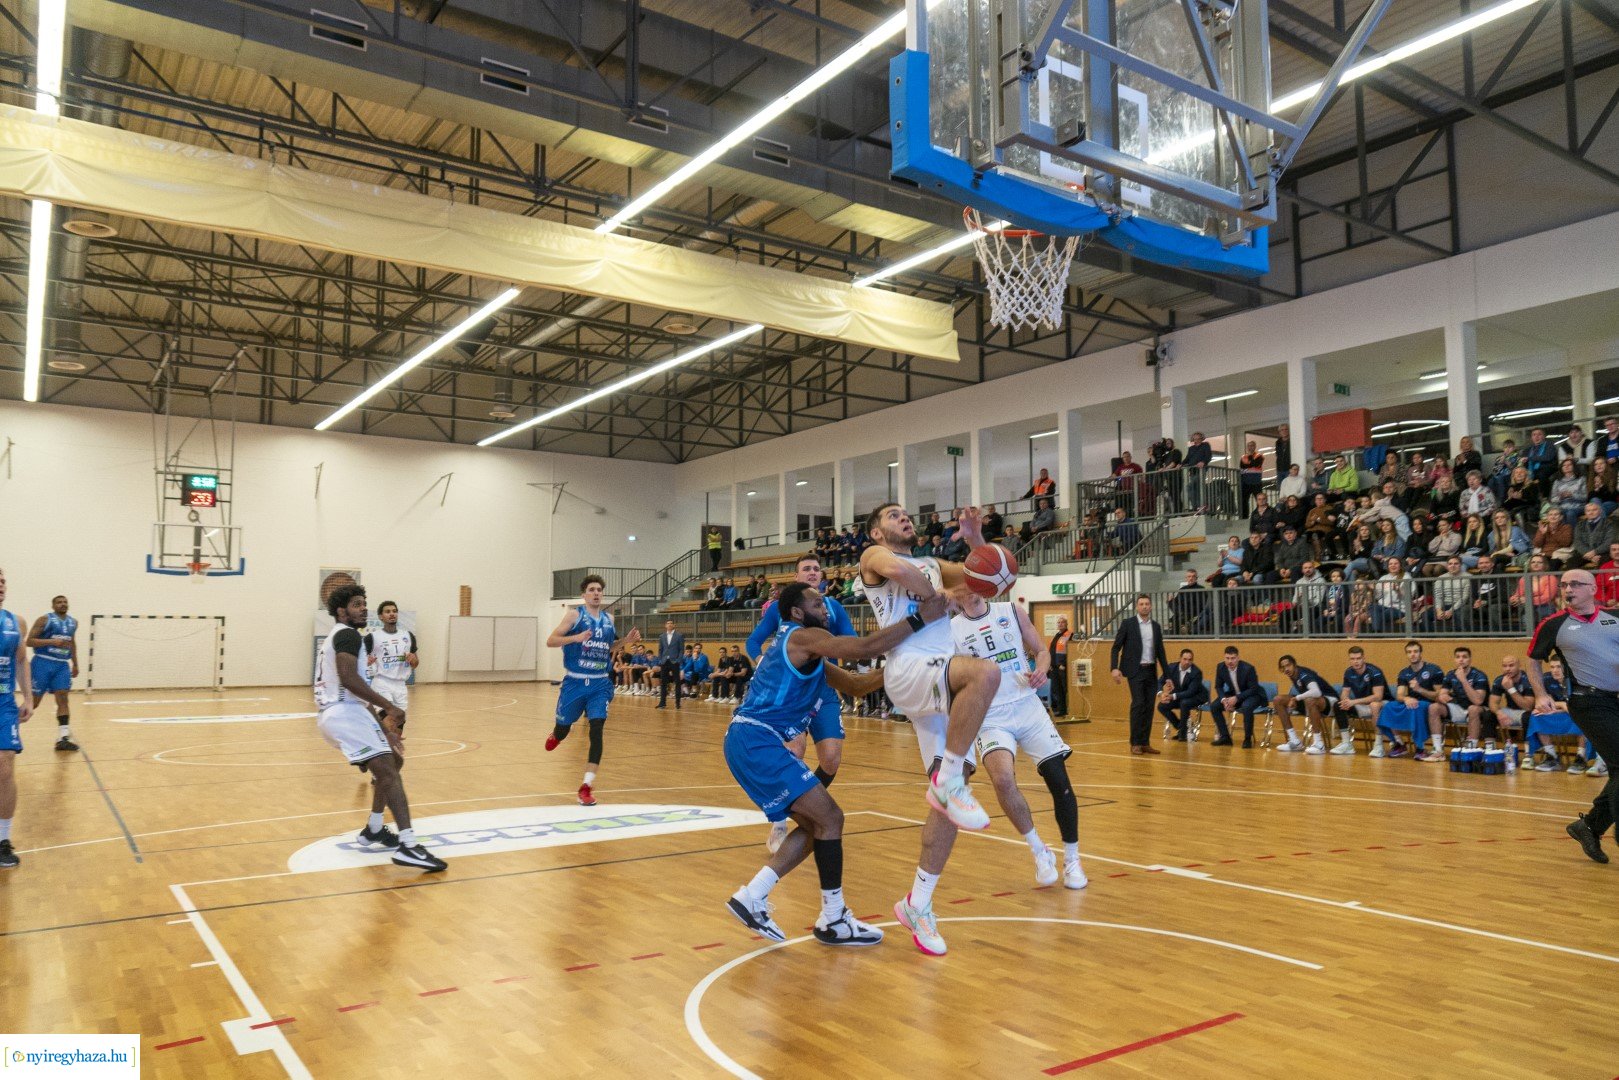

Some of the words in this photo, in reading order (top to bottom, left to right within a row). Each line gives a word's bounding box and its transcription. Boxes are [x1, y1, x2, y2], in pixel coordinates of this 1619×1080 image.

[595, 627, 602, 638] 21
[985, 635, 996, 651] 6
[335, 808, 724, 853] PPMIX
